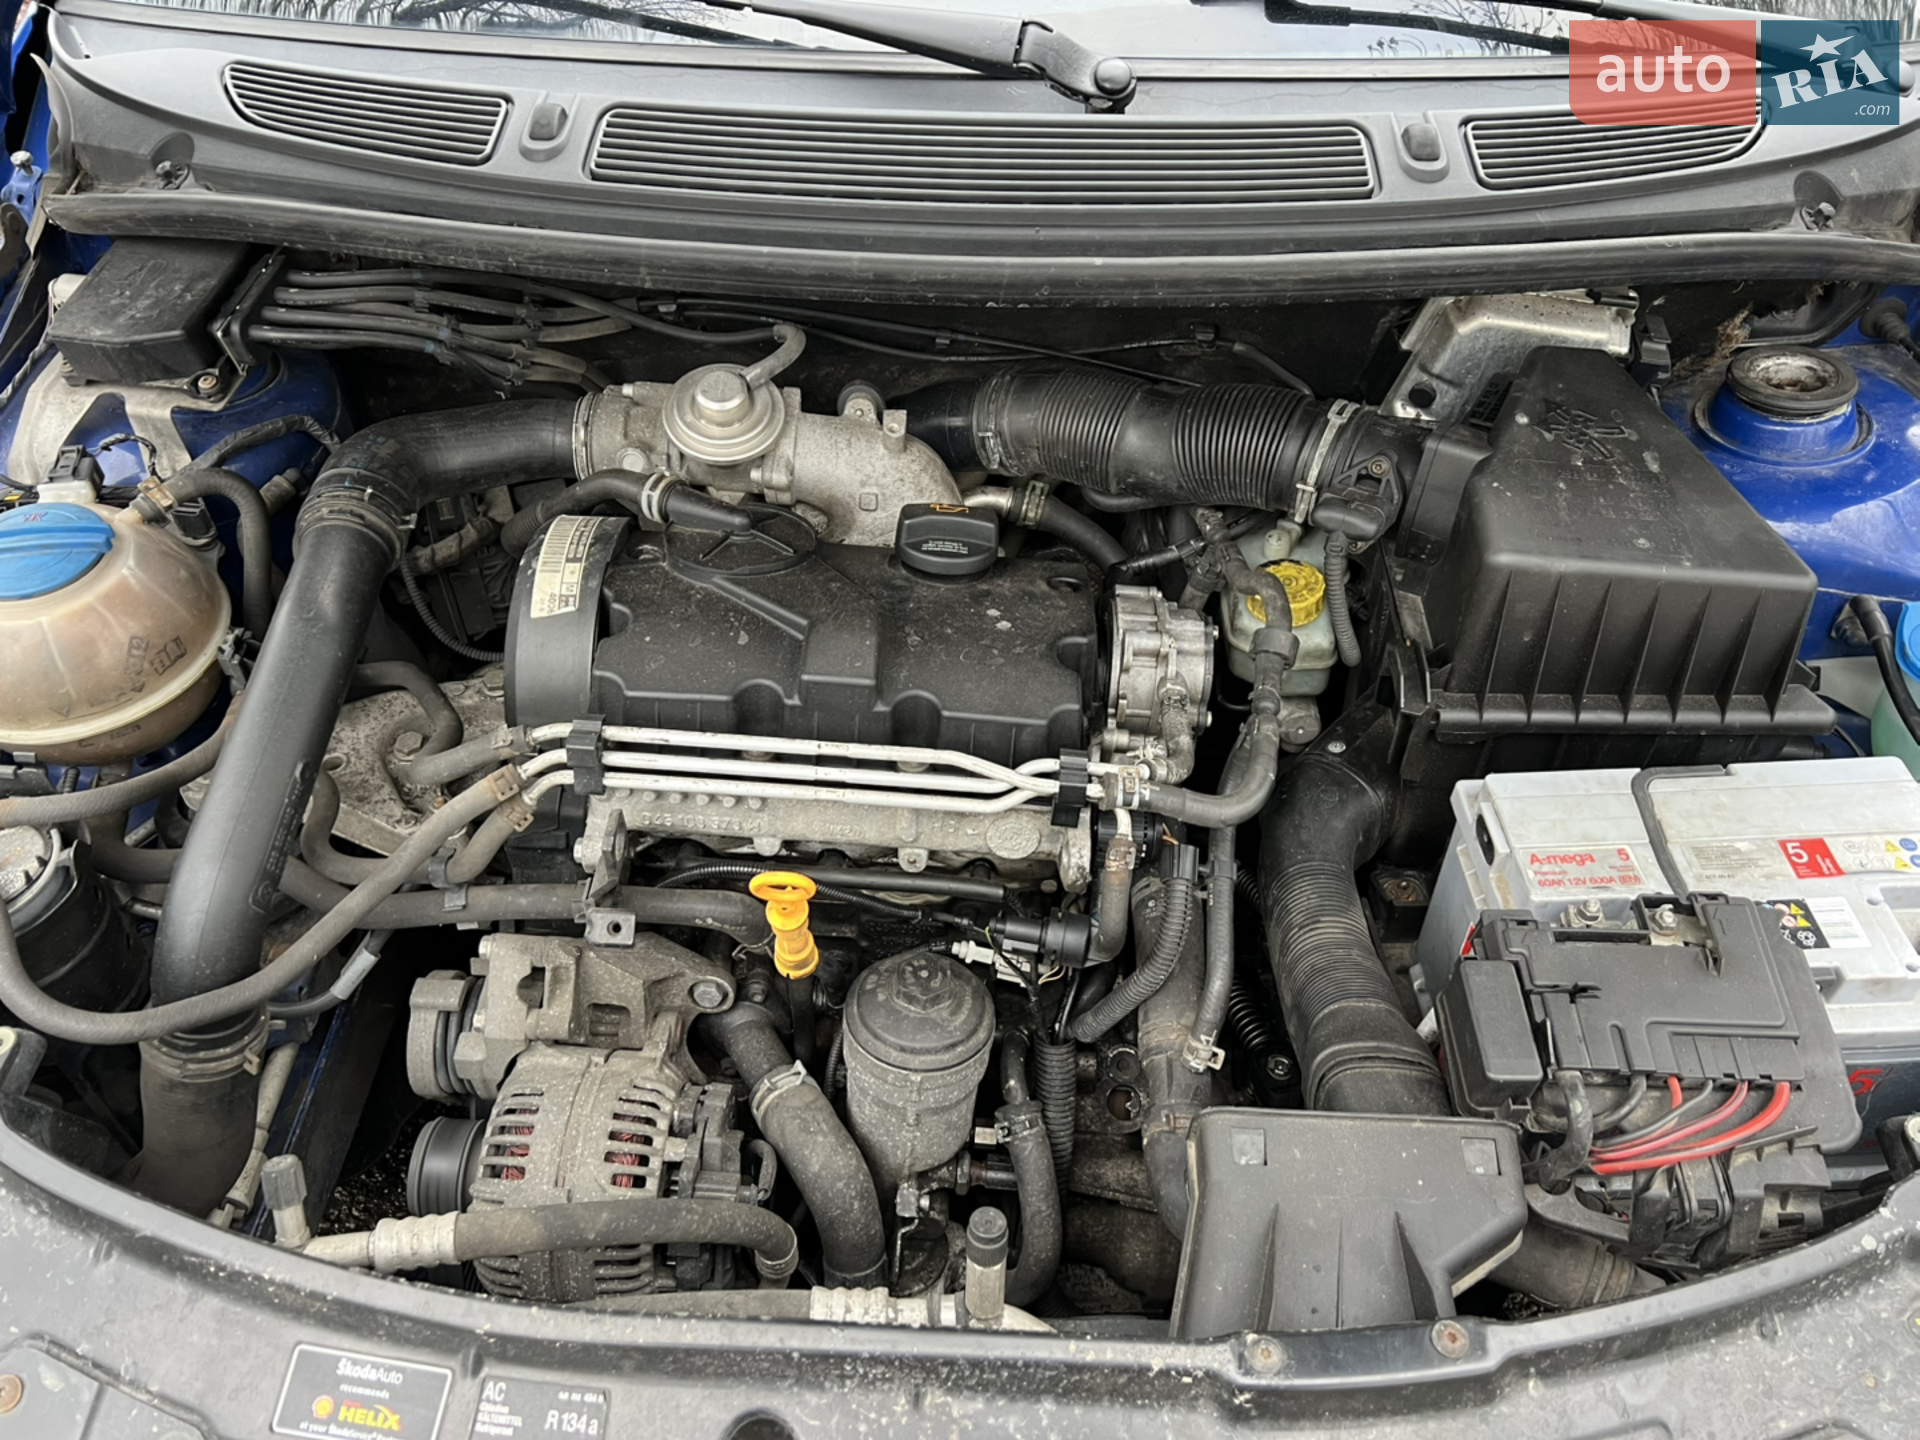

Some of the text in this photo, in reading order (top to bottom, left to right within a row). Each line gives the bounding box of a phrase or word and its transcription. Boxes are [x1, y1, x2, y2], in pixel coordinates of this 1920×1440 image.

[1530, 847, 1630, 867] A-mega 5
[1785, 842, 1809, 864] 5
[1567, 876, 1587, 886] 12V
[482, 1380, 507, 1402] AC
[338, 1404, 402, 1431] HELIX
